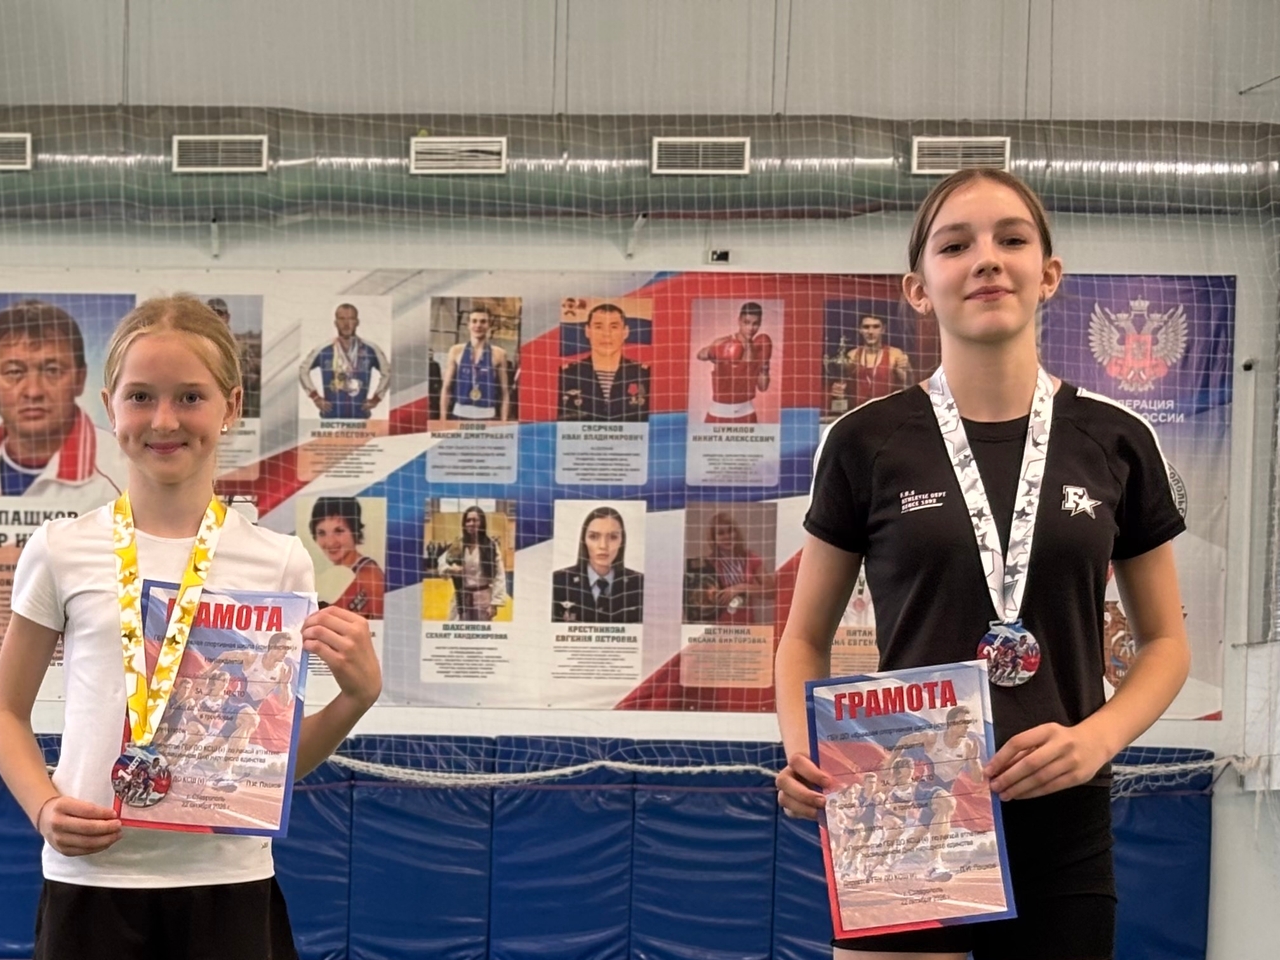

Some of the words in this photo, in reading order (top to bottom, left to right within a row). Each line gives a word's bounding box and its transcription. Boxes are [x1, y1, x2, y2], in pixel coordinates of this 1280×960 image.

[1117, 400, 1174, 410] ДЕРАЦИЯ
[1141, 413, 1185, 423] ОССИИ
[688, 636, 718, 644] ОКСАНА
[834, 680, 958, 721] ГРАМОТА
